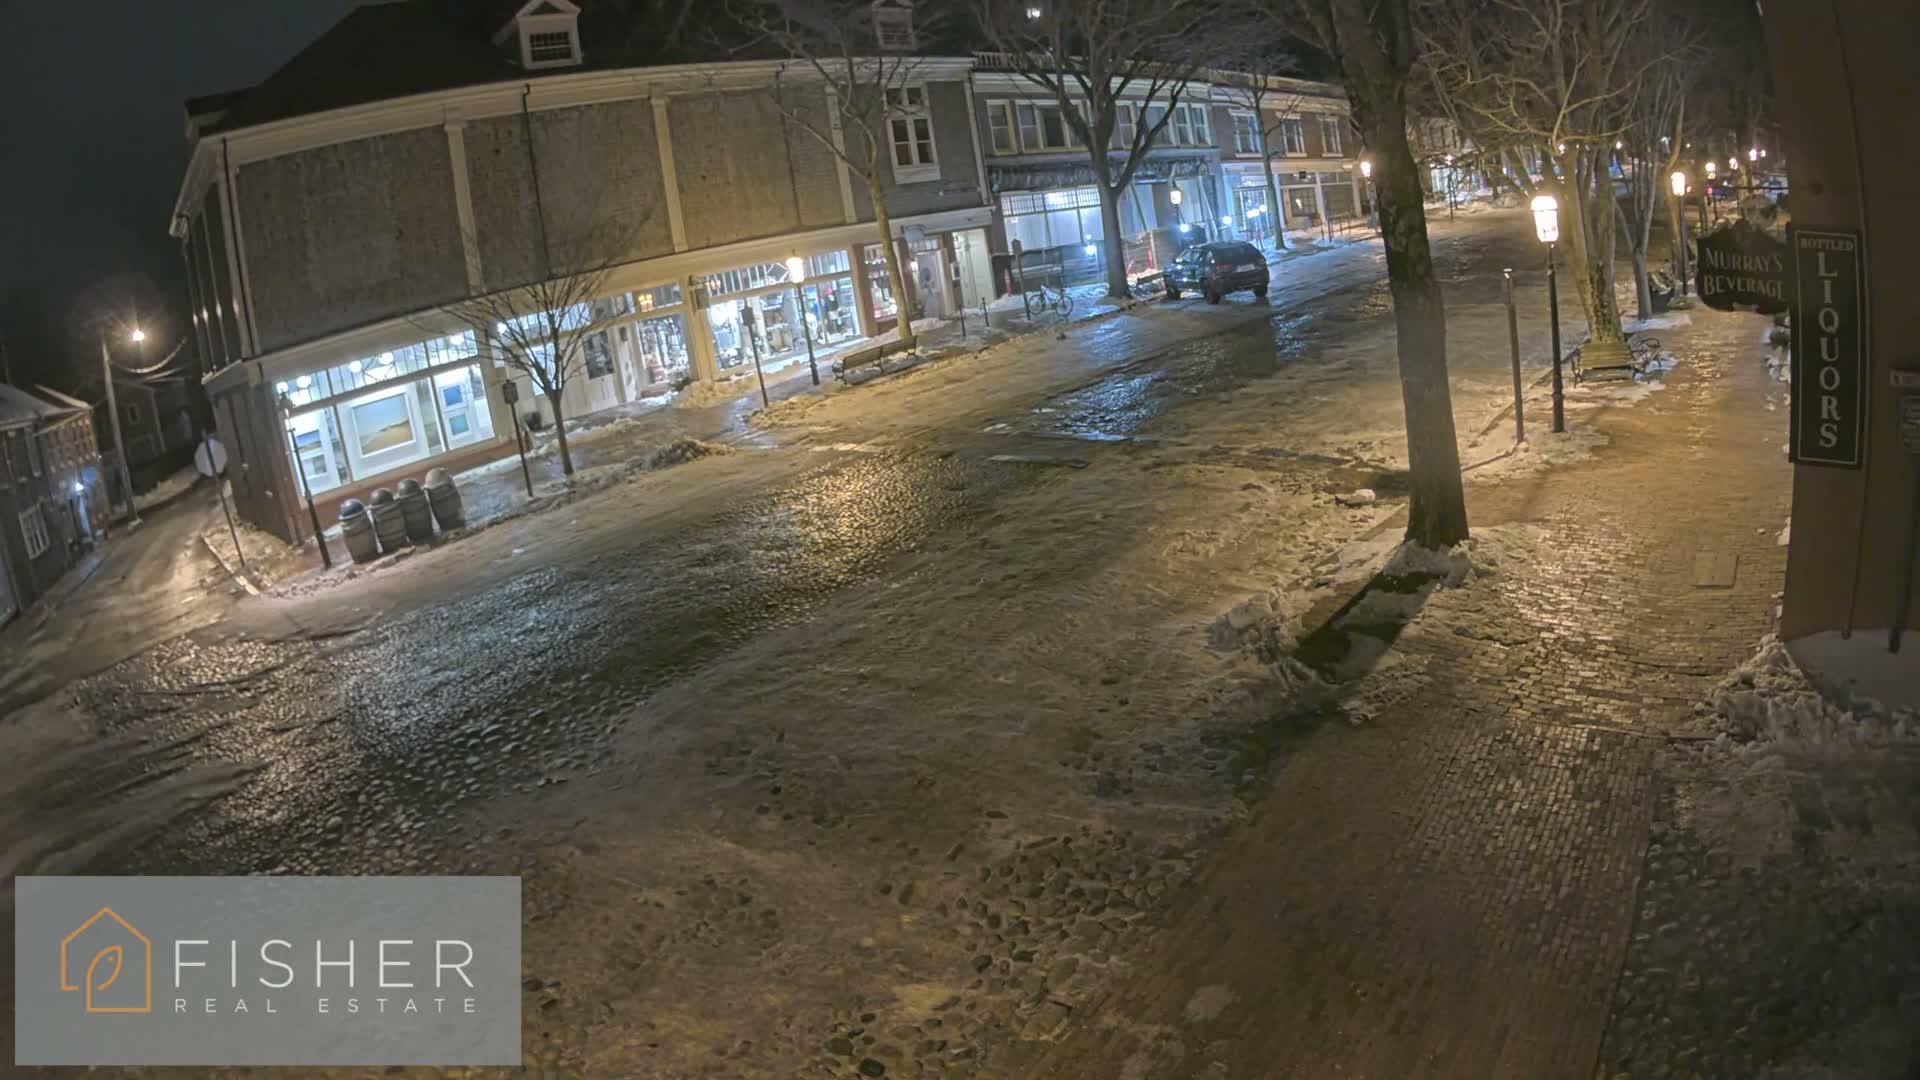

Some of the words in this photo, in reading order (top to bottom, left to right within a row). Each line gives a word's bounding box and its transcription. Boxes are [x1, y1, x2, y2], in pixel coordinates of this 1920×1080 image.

[1799, 238, 1854, 252] BOTTLED
[1704, 247, 1784, 273] MURRAY'S
[1703, 274, 1784, 300] BEVERAGE
[1816, 251, 1841, 448] LIQUORS
